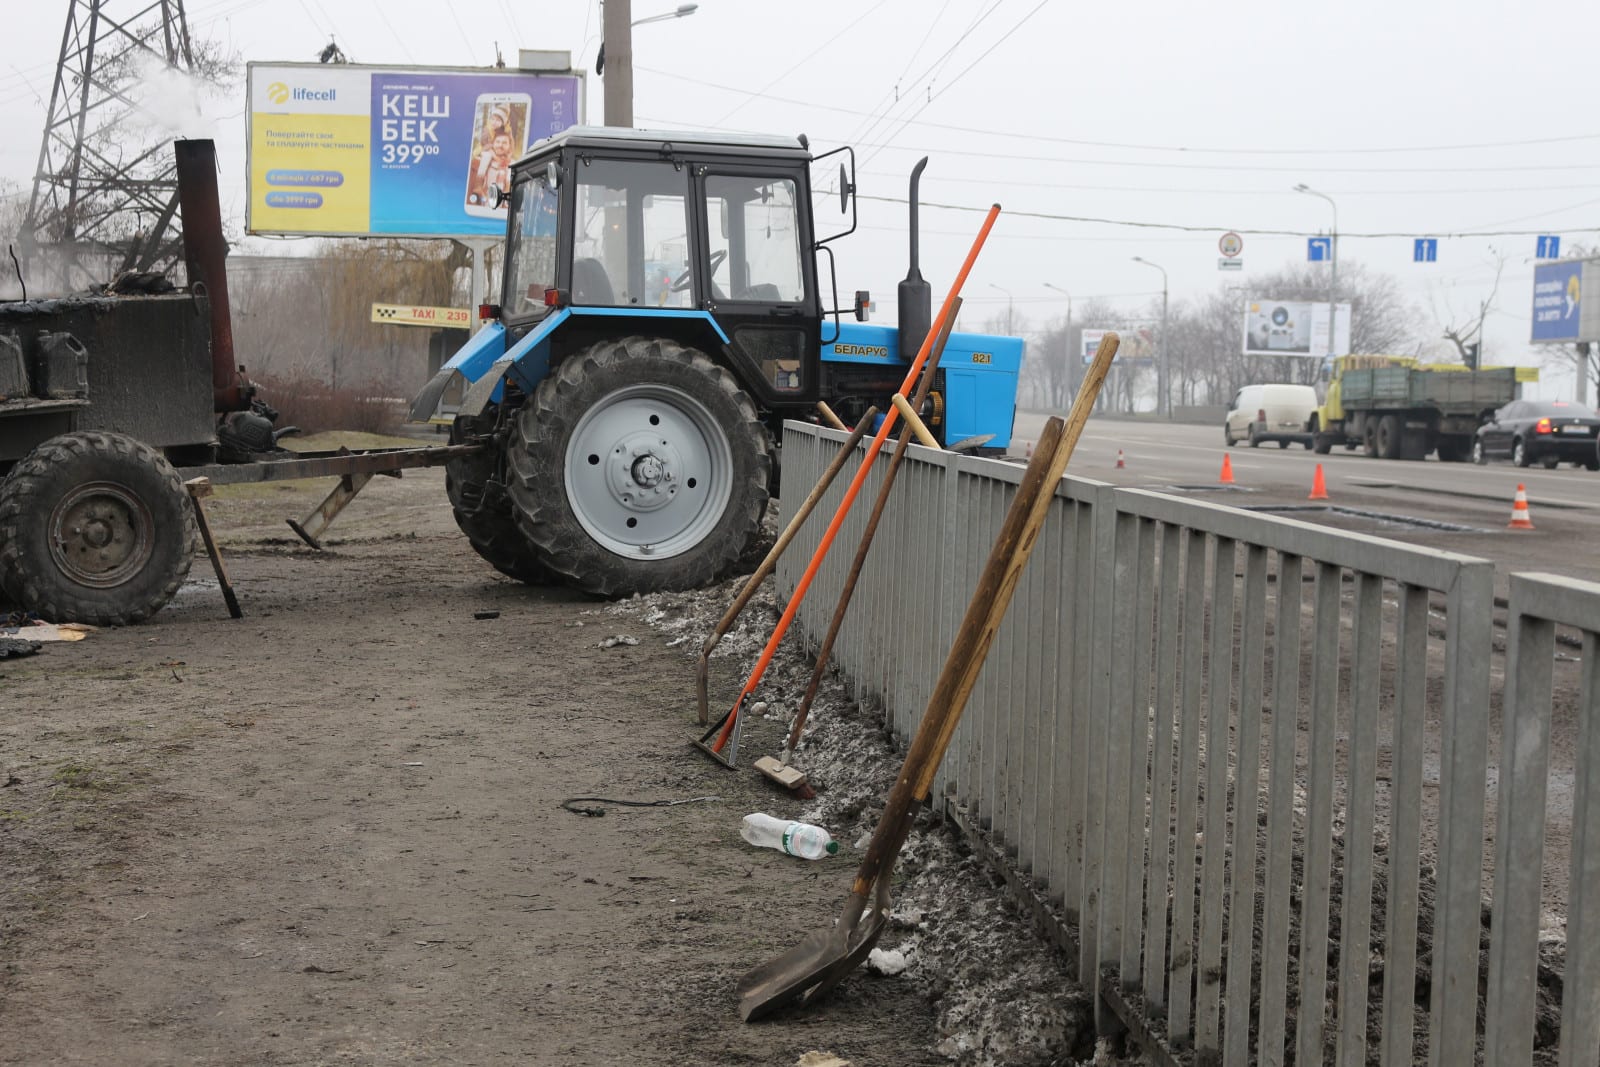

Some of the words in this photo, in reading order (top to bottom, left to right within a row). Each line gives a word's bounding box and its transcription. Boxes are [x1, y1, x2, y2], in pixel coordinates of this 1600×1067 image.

[293, 88, 336, 101] lifecell
[382, 94, 450, 118] КЕШ
[382, 119, 439, 142] БЕК
[412, 308, 436, 319] TAXI
[447, 311, 468, 321] 239
[834, 344, 889, 357] БЕЛАРУС
